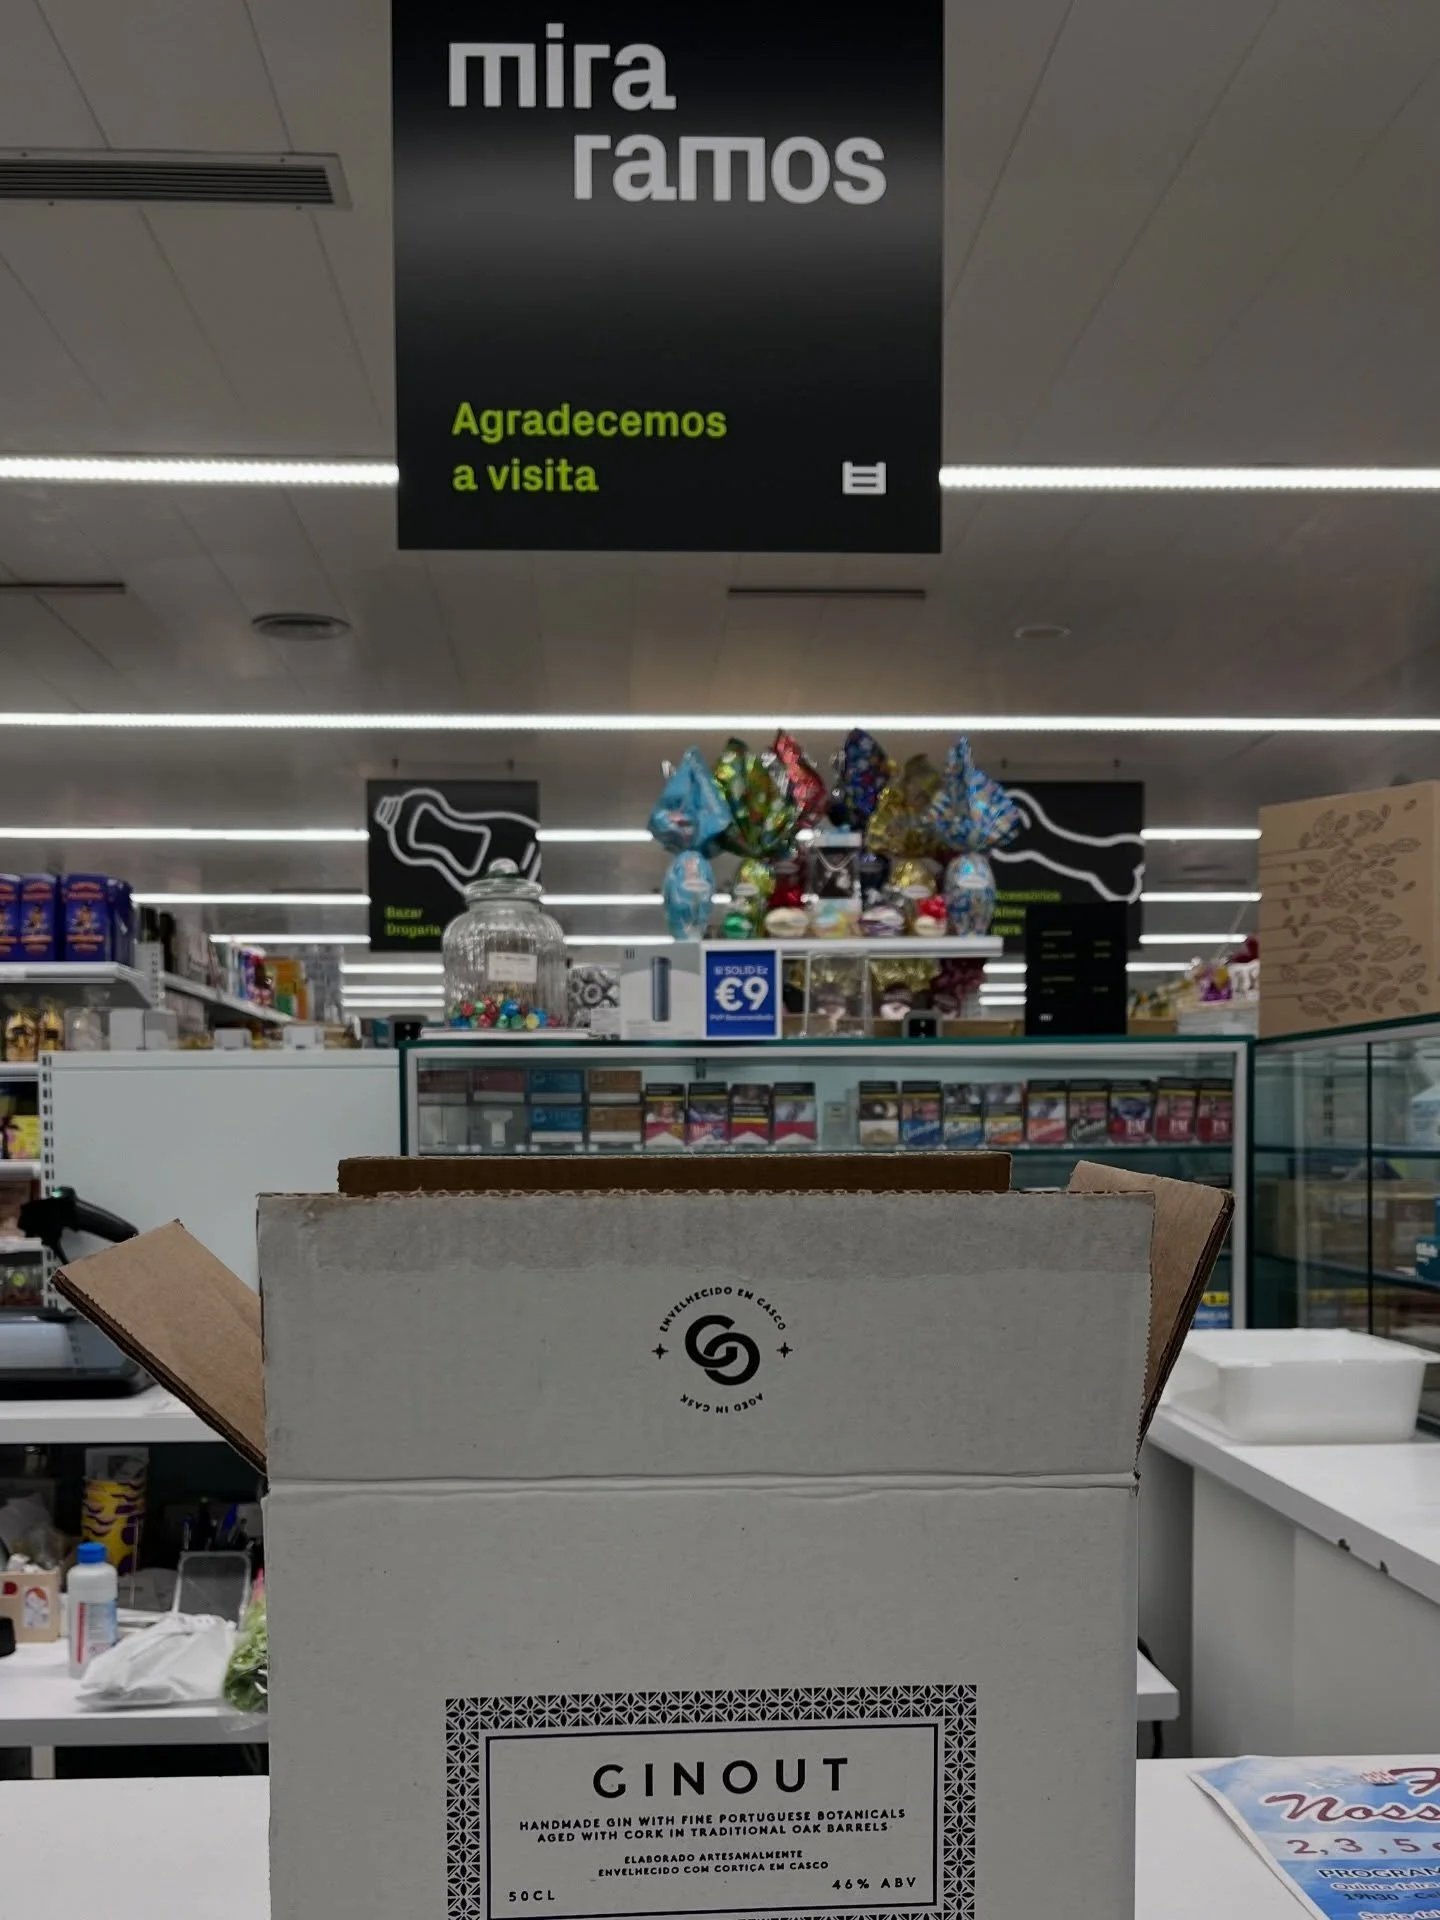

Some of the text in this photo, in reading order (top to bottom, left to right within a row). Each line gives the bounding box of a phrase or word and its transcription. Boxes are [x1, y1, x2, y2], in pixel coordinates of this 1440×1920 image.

[448, 22, 677, 110] mira
[573, 133, 887, 204] ramos
[452, 401, 728, 443] Agradecemos
[452, 458, 600, 491] a visita
[725, 965, 755, 975] SOLID
[714, 976, 769, 1012] €9
[659, 1286, 786, 1332] ENVELHECIDO EM CASCO
[680, 1392, 764, 1414] AGED IN CASK
[593, 1757, 848, 1798] GINOUT
[520, 1809, 905, 1831] HANDMADE GIN WITH FINE PORTUGUESE BOTANICALS
[537, 1822, 888, 1843] AGED WITH CORK IN TRADITIONAL OAK BARRELS
[624, 1850, 803, 1864] ELABORADO ARTESANALMENTE
[598, 1861, 829, 1877] ENVELHECIDO COM CORTIÇA EM CASCO
[832, 1876, 916, 1890] 46% ABV
[509, 1889, 555, 1902] 50CL
